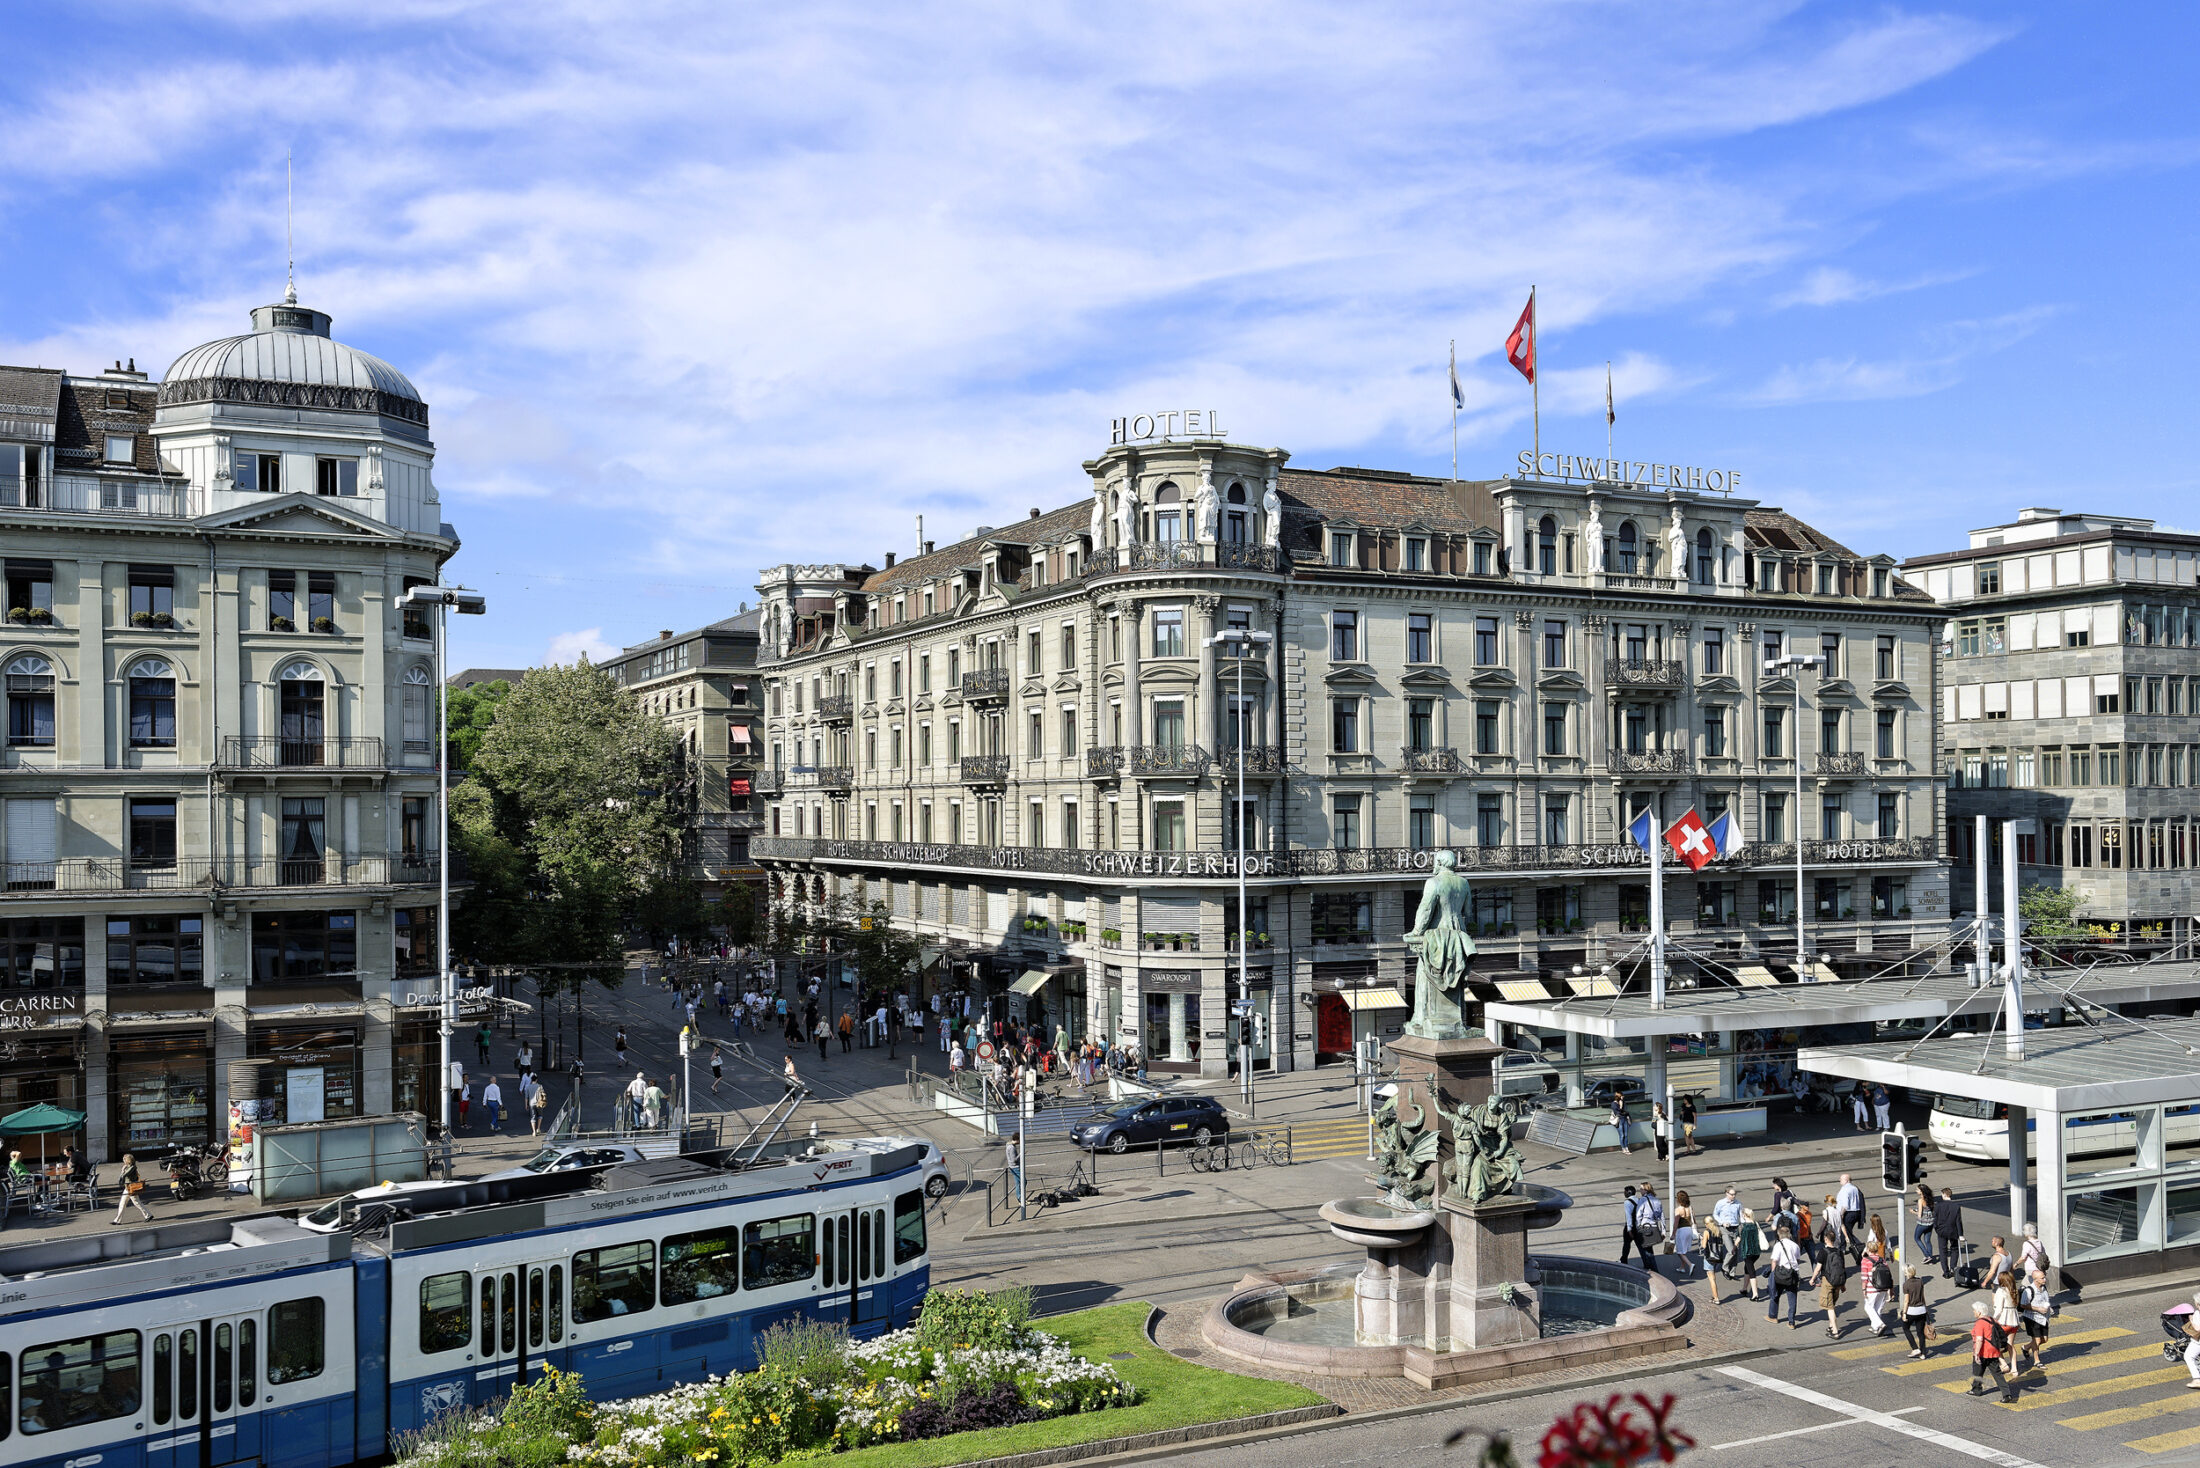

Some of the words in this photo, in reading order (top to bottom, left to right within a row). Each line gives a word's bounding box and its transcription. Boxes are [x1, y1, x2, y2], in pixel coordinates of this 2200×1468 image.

[1110, 410, 1228, 445] HOTEL
[1517, 450, 1742, 493] SCHWEIZERHOF
[827, 842, 851, 857] HOTEL
[883, 845, 949, 861] SCHWEIZERHOF
[1397, 851, 1467, 868] HOTL
[1825, 843, 1881, 859] HOTEL
[990, 850, 1025, 868] HOTEL
[1085, 855, 1275, 875] SCHWEIZERHOF
[861, 920, 872, 928] 30
[1151, 973, 1191, 982] SWAROVSKI
[824, 1159, 853, 1170] VERIT
[591, 1200, 628, 1211] Steigen
[626, 1196, 640, 1206] Sie
[641, 1193, 655, 1203] ein
[656, 1190, 671, 1201] auf
[673, 1182, 728, 1199] www.verit.ch
[668, 1247, 677, 1259] 3
[171, 1275, 196, 1284] ZÜRICH
[228, 1267, 247, 1275] CHUR
[0, 1291, 26, 1304] inie
